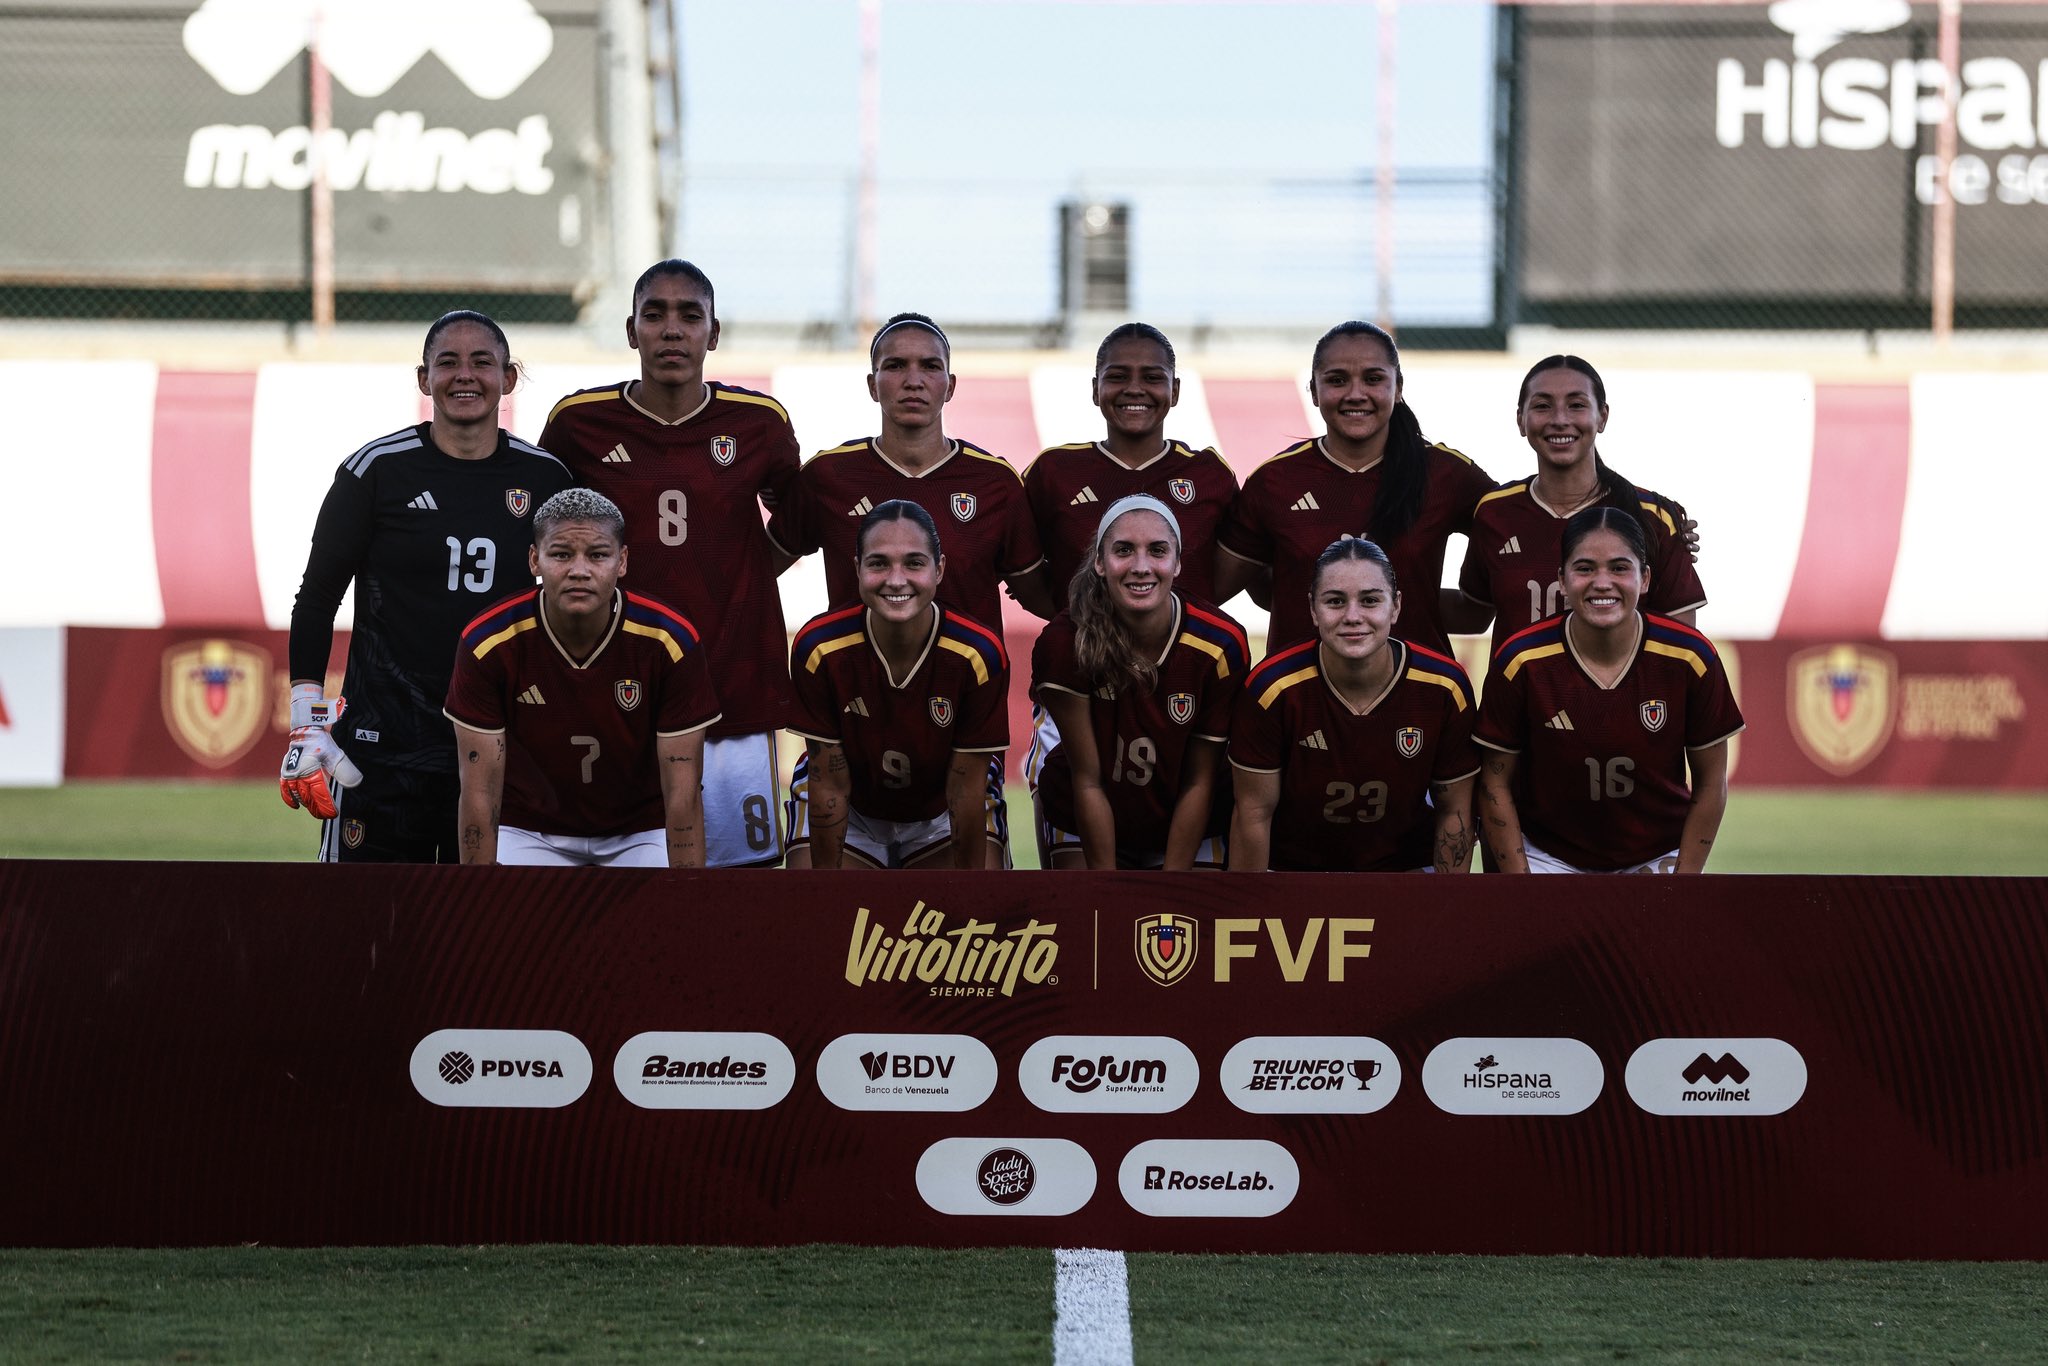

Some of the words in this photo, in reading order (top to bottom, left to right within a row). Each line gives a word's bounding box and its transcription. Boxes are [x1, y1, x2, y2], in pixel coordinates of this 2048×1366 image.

[184, 110, 555, 195] movilnet
[658, 489, 688, 547] 8
[446, 536, 497, 593] 13
[570, 735, 601, 784] 7
[882, 750, 911, 789] 9
[1112, 734, 1157, 786] 19
[1585, 756, 1635, 801] 16
[1322, 780, 1388, 824] 23
[742, 794, 771, 851] 8
[903, 900, 946, 937] La
[1214, 918, 1375, 982] FVF
[929, 986, 995, 997] SIEMPRE
[481, 1060, 564, 1078] PDVSA
[642, 1055, 767, 1078] Bandes
[892, 1055, 955, 1079] BDV
[1051, 1055, 1167, 1084] Forum
[1252, 1060, 1344, 1074] TRIUNFO
[865, 1086, 890, 1094] Banco
[892, 1086, 903, 1094] de
[904, 1086, 949, 1095] Venezuela
[1105, 1085, 1164, 1093] SuperMayorista
[1249, 1076, 1344, 1090] BET.COM
[1682, 1088, 1750, 1101] movilnet
[981, 1163, 1030, 1189] Speed
[992, 1155, 1023, 1173] lady
[990, 1180, 1026, 1198] Stick
[1168, 1171, 1274, 1190] RoseLab.
